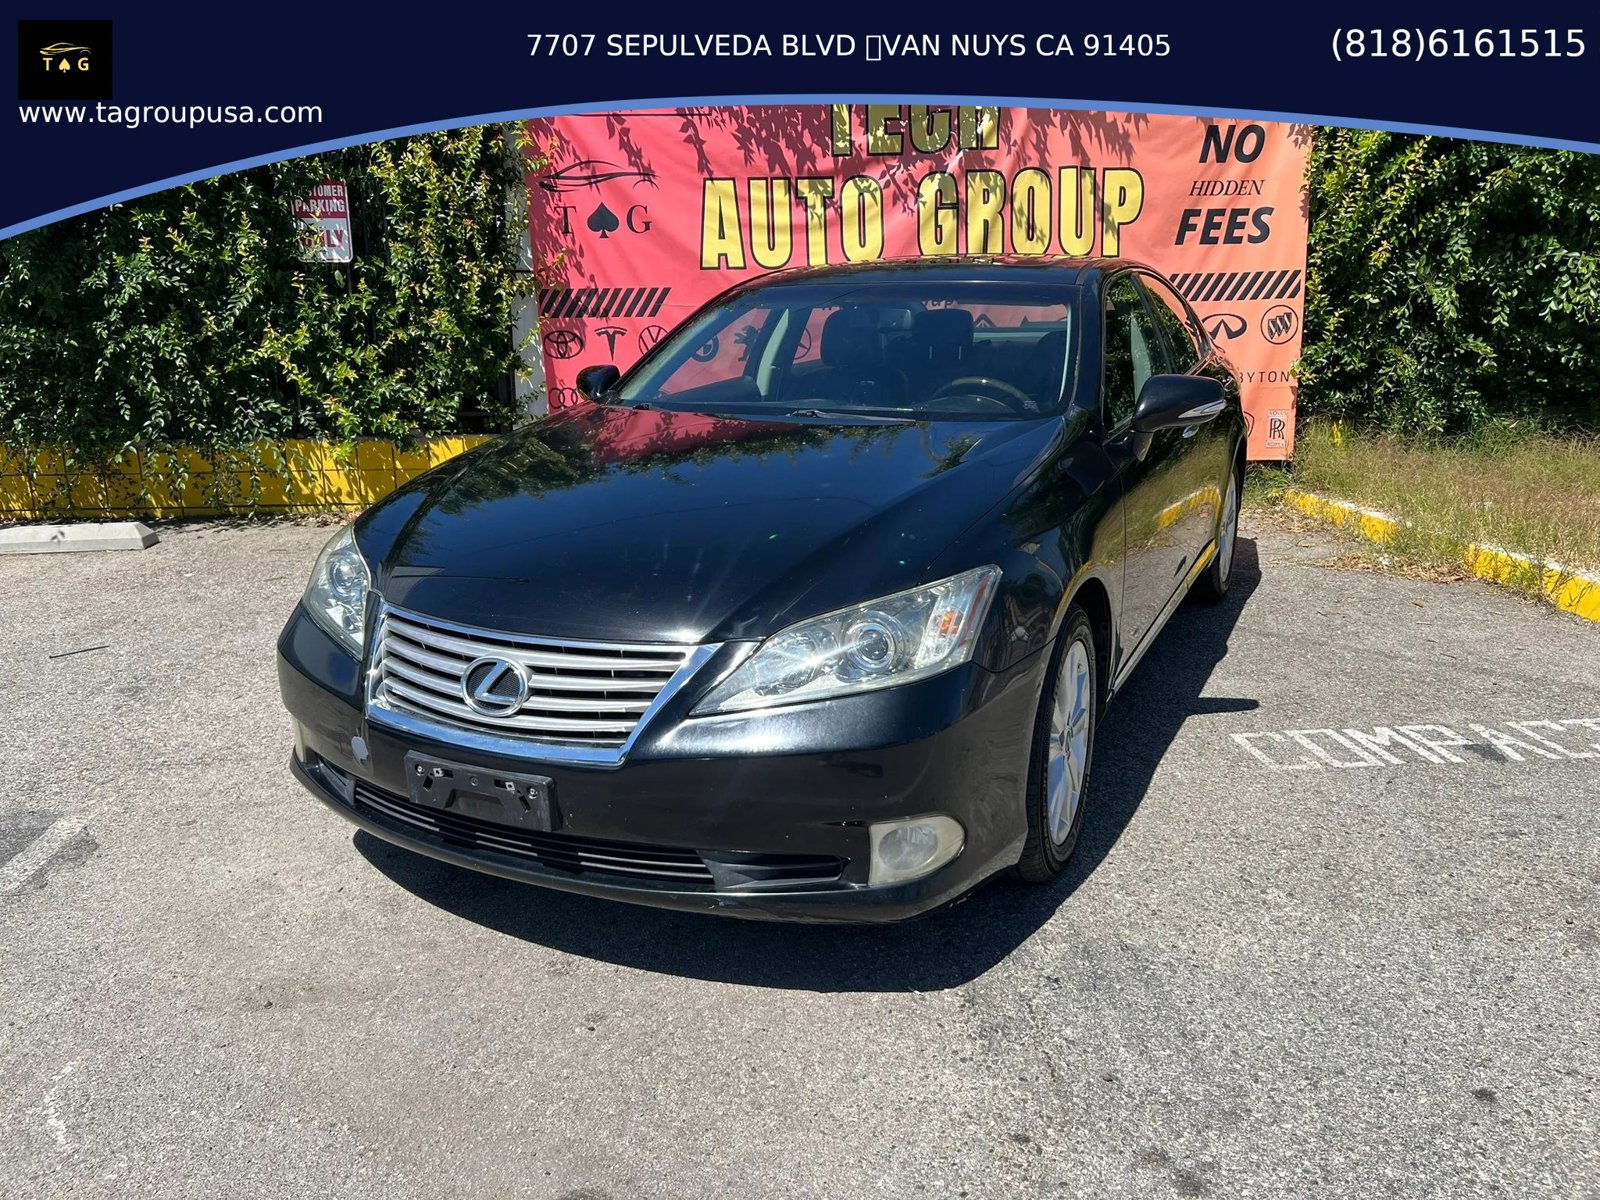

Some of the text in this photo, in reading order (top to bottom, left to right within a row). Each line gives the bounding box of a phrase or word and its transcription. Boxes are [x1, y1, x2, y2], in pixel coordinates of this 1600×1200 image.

[1198, 124, 1266, 164] NO
[1188, 179, 1266, 197] HIDDEN
[294, 199, 345, 212] PARKING
[700, 166, 1145, 270] AUTO GROUP
[301, 229, 344, 248] OLY
[1174, 206, 1275, 246] FEES
